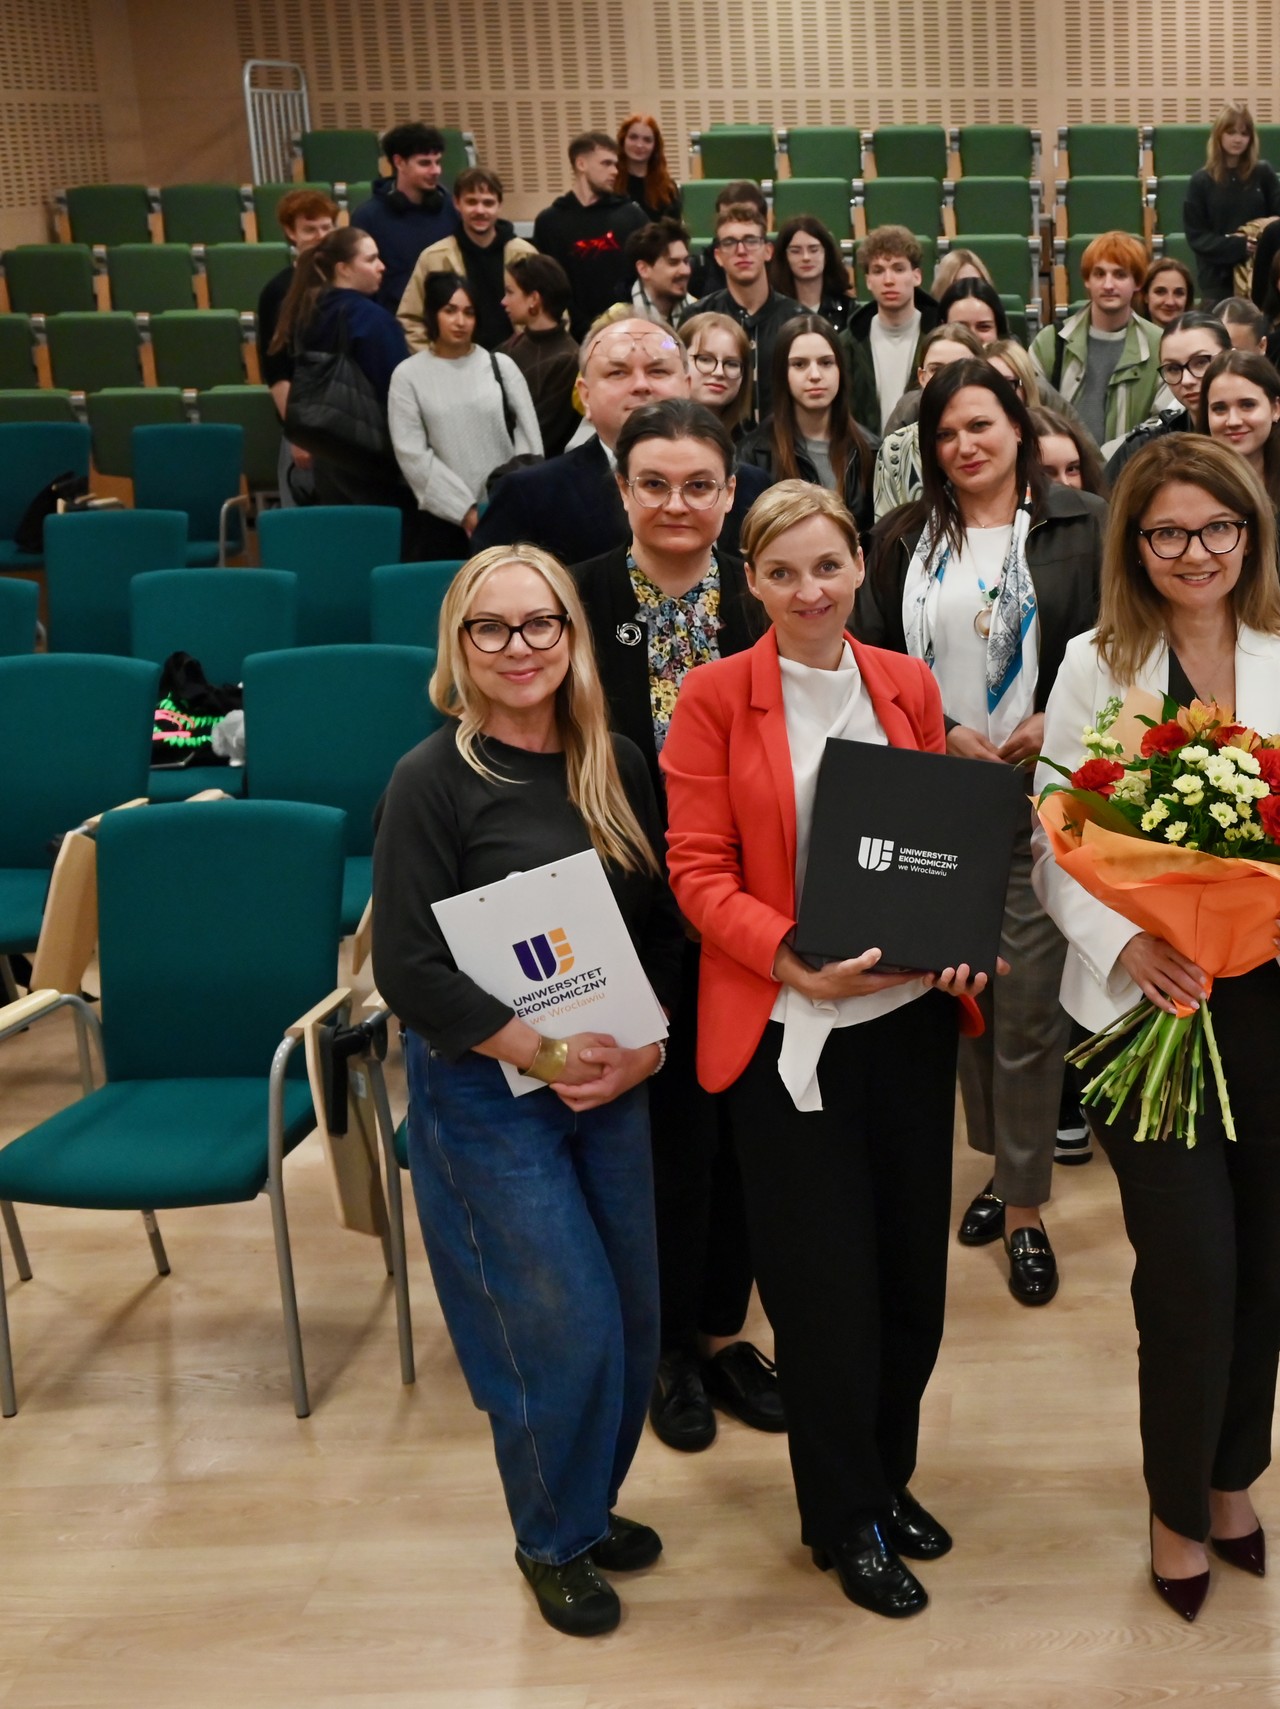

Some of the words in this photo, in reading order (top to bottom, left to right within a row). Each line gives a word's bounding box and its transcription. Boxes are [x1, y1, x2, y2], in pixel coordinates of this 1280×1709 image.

[900, 847, 958, 862] UNIWERSYTET
[898, 855, 959, 870] EKONOMICZNY
[910, 864, 947, 877] Wrocławiu
[513, 967, 602, 1007] UNIWERSYTET
[516, 977, 607, 1018] EKONOMICZNY
[530, 1014, 547, 1025] we
